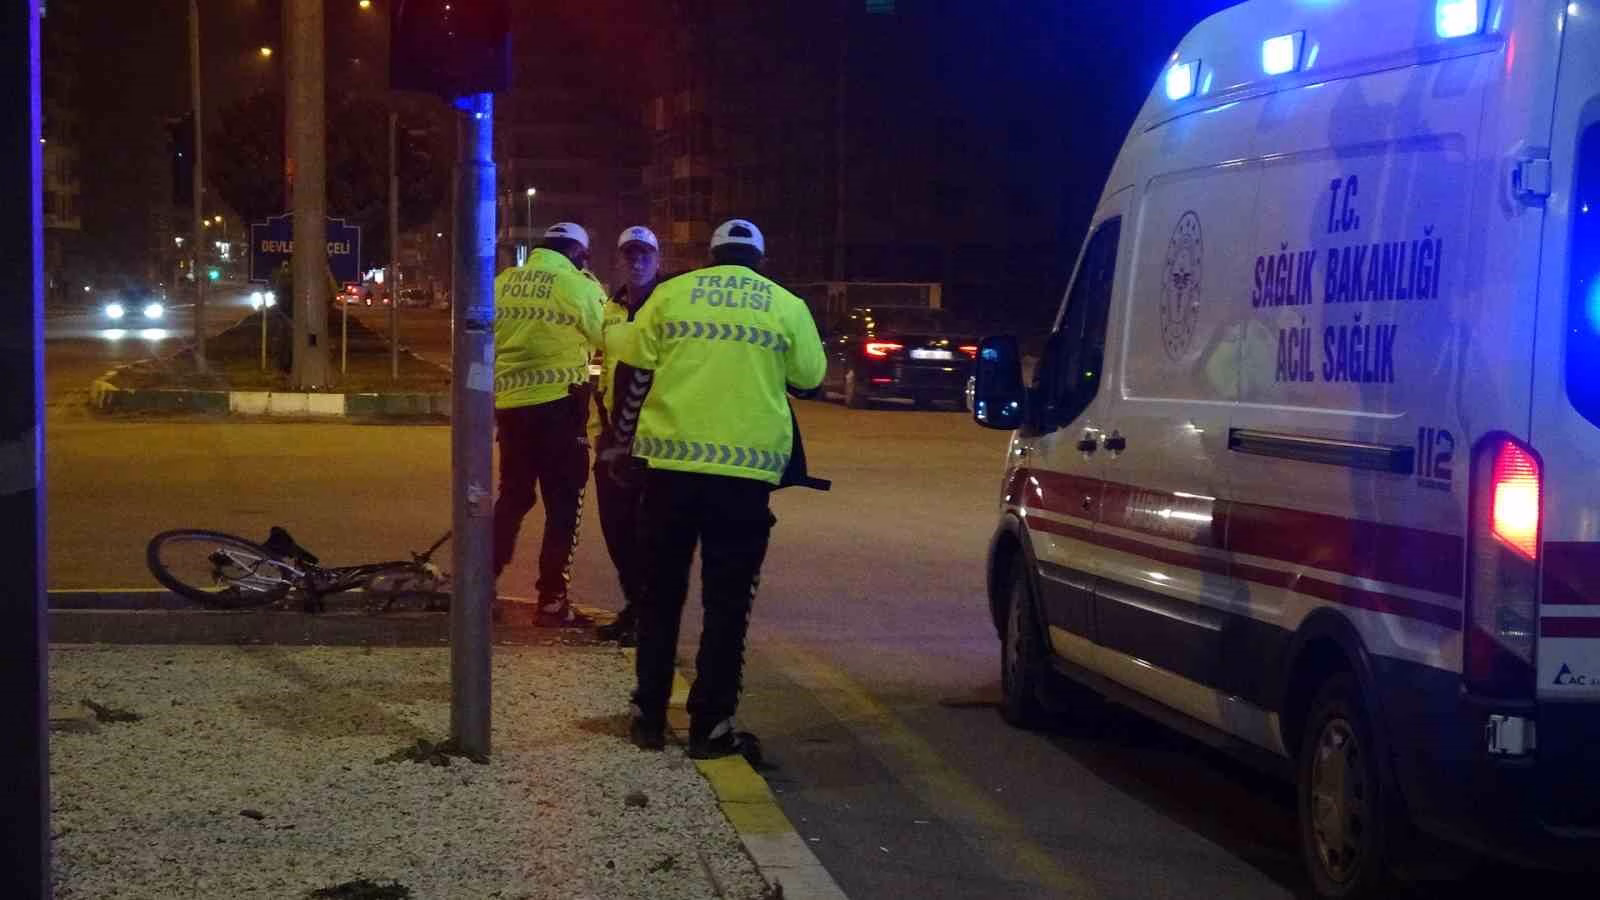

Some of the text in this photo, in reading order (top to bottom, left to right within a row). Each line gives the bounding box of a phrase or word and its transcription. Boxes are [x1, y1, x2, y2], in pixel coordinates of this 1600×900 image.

[1327, 174, 1360, 233] T.C.
[261, 240, 296, 253] DEVLE
[1252, 223, 1443, 308] SAĞLIK BAKANLIĞI
[502, 283, 552, 299] POLİSİ
[690, 288, 770, 312] POLİSİ
[1275, 311, 1398, 383] ACİL SAĞLIK
[1417, 426, 1455, 480] 112
